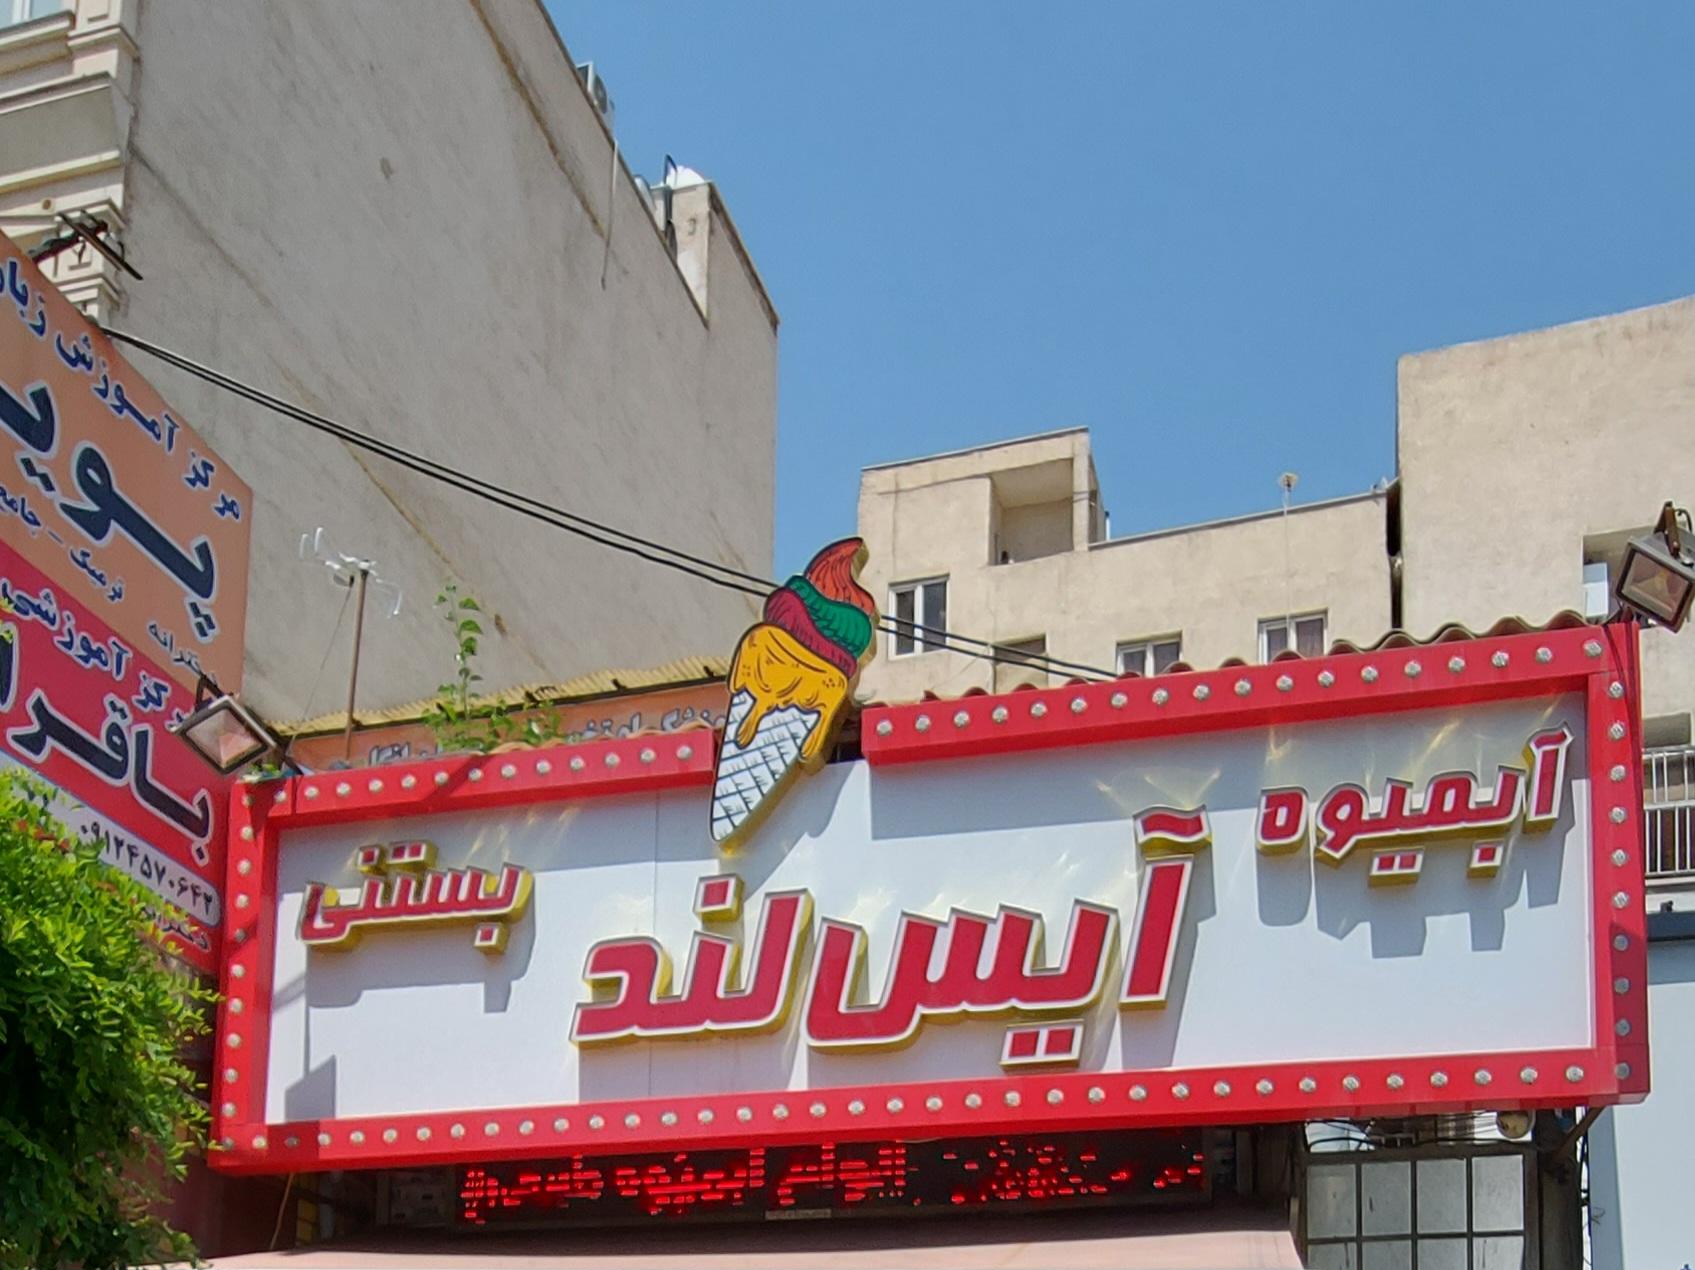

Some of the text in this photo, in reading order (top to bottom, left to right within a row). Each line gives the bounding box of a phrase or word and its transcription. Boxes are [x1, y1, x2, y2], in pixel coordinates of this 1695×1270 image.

[0, 259, 46, 337] زبا
[56, 334, 180, 453] آموزش
[1257, 722, 1575, 884] آبمیوه
[297, 840, 534, 953] بستنی
